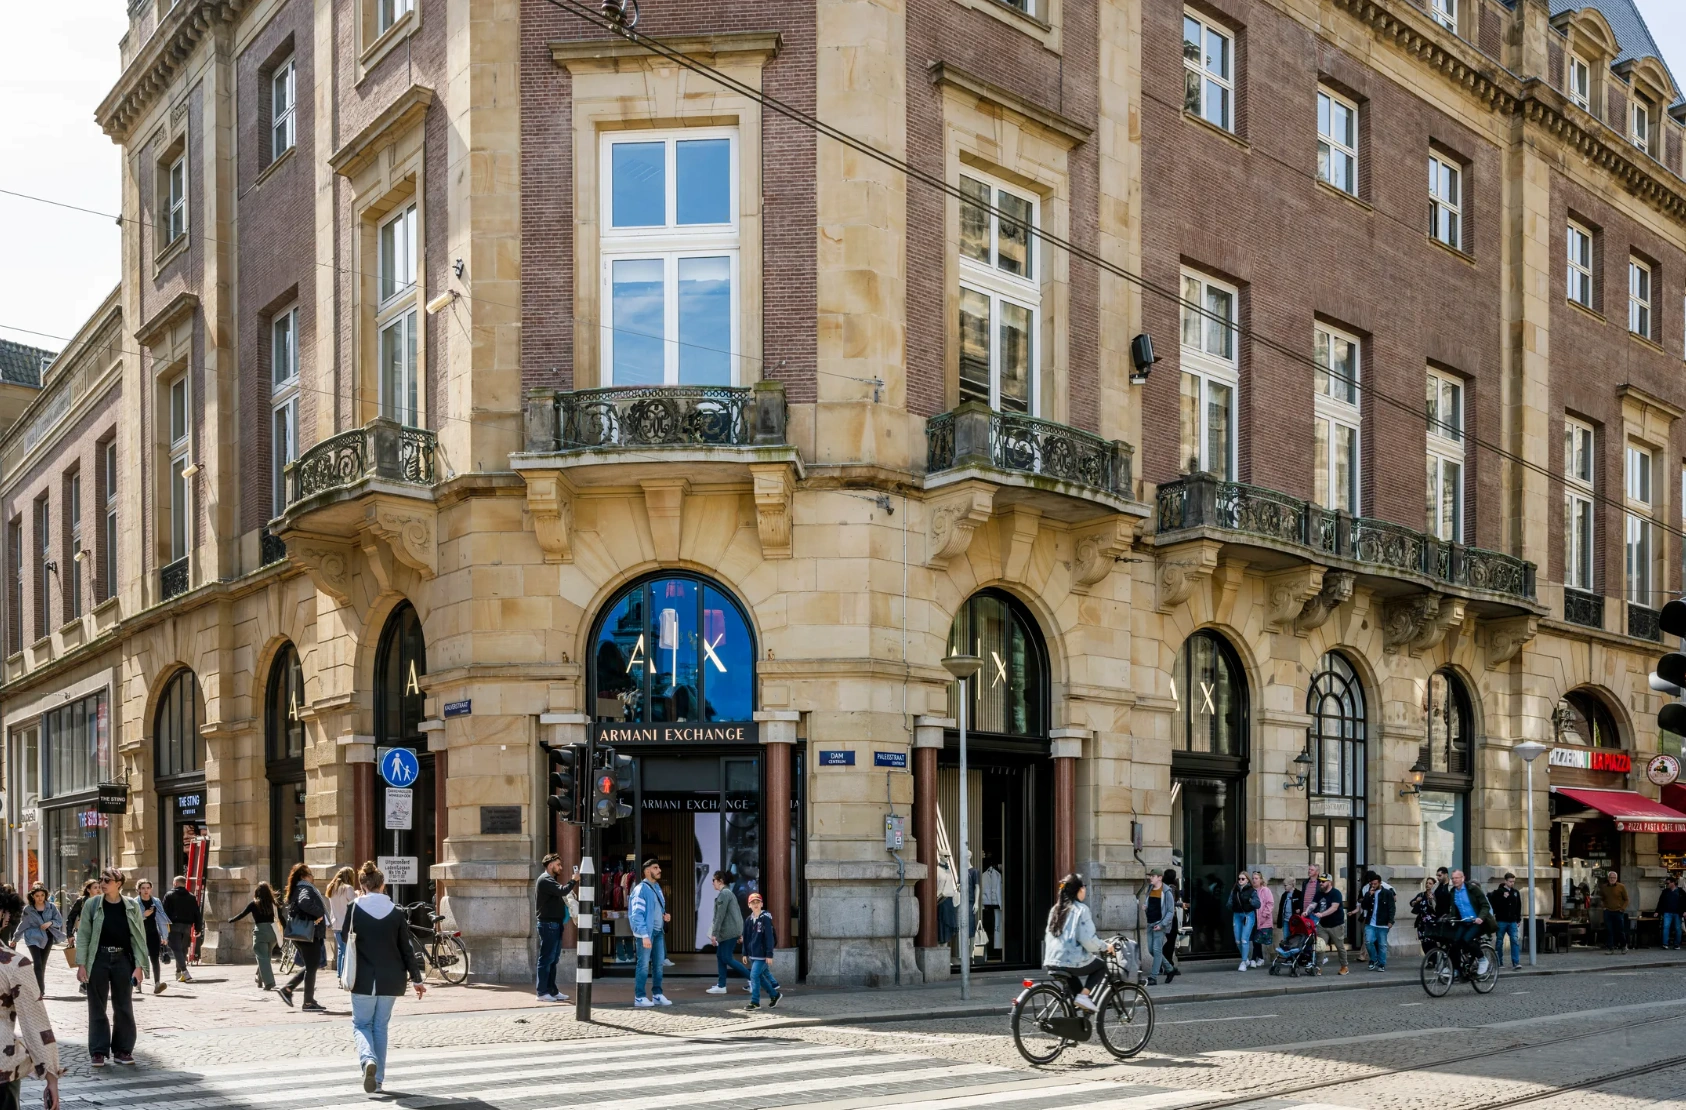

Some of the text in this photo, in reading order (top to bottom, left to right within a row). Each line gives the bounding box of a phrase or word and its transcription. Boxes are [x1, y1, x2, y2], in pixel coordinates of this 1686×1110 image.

[600, 728, 745, 741] ARMANI EXCHANGE
[1549, 747, 1631, 773] PIZZERIA LA PIAZZA
[178, 794, 200, 807] THE STING
[641, 800, 749, 810] ARMANI EXCHNGE
[1628, 822, 1643, 831] PIZZA
[1644, 822, 1660, 831] PASTA
